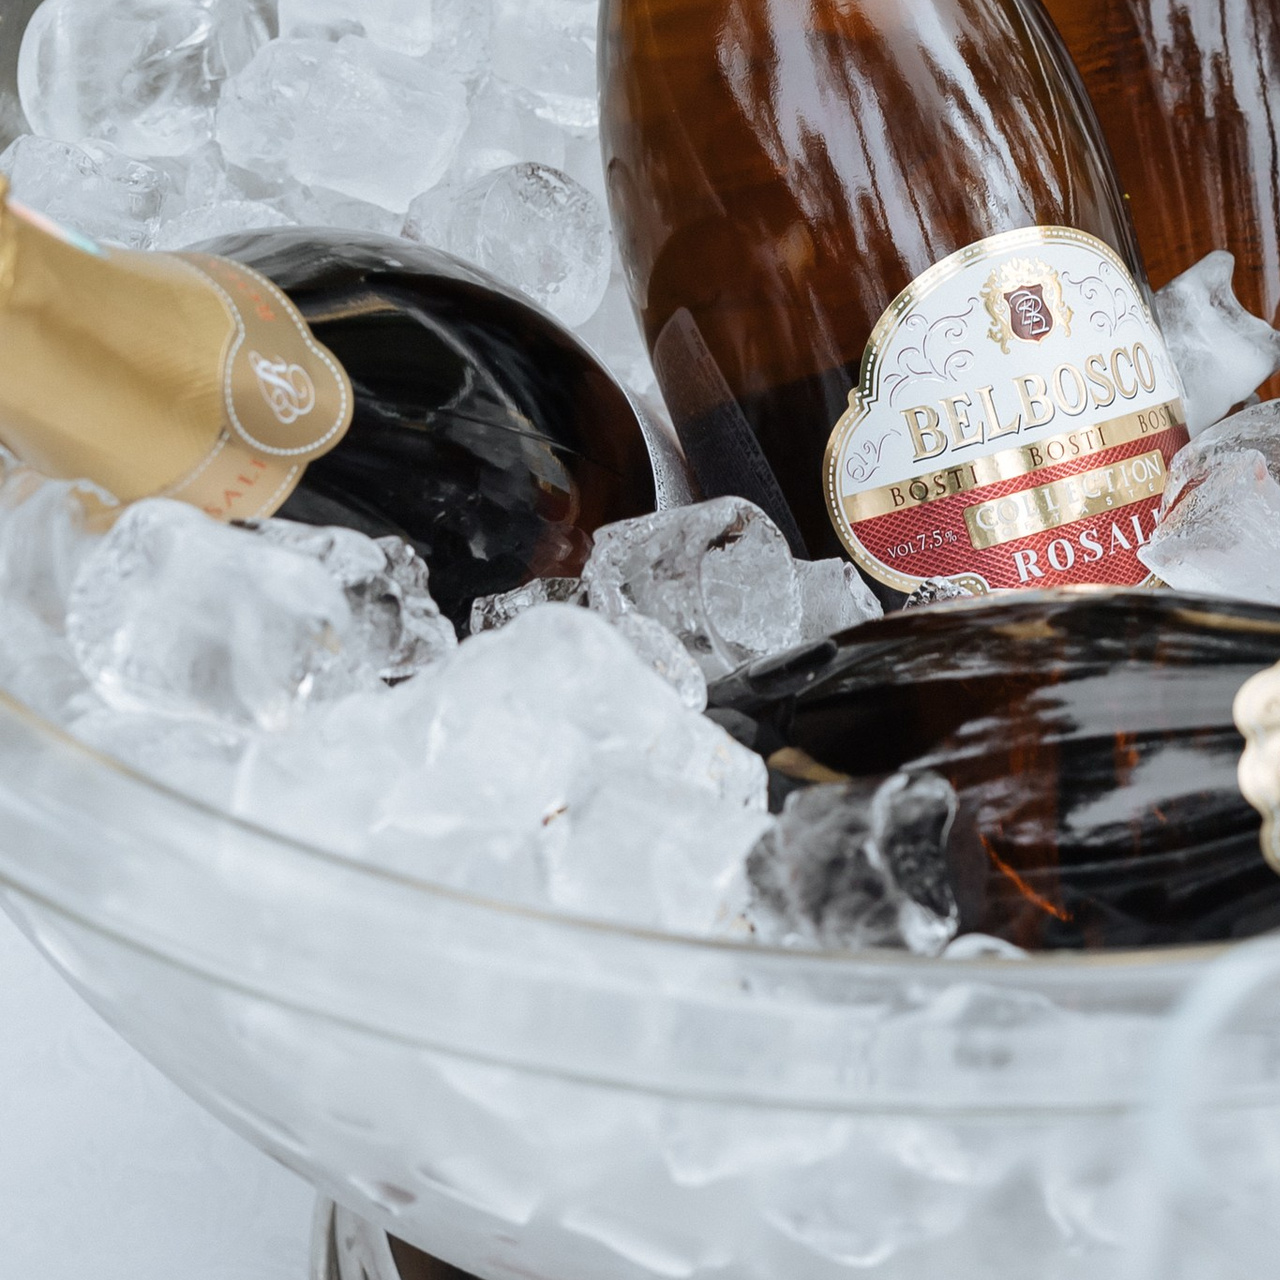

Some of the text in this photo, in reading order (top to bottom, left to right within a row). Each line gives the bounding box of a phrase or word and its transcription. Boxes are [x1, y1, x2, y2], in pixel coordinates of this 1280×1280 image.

[901, 341, 1157, 463] BELBOSCO
[891, 467, 978, 507] BOSTI
[1029, 429, 1107, 467] BOSTI
[975, 454, 1162, 531] COLLECTION
[1050, 483, 1155, 522] TASTE
[887, 542, 917, 560] VOL
